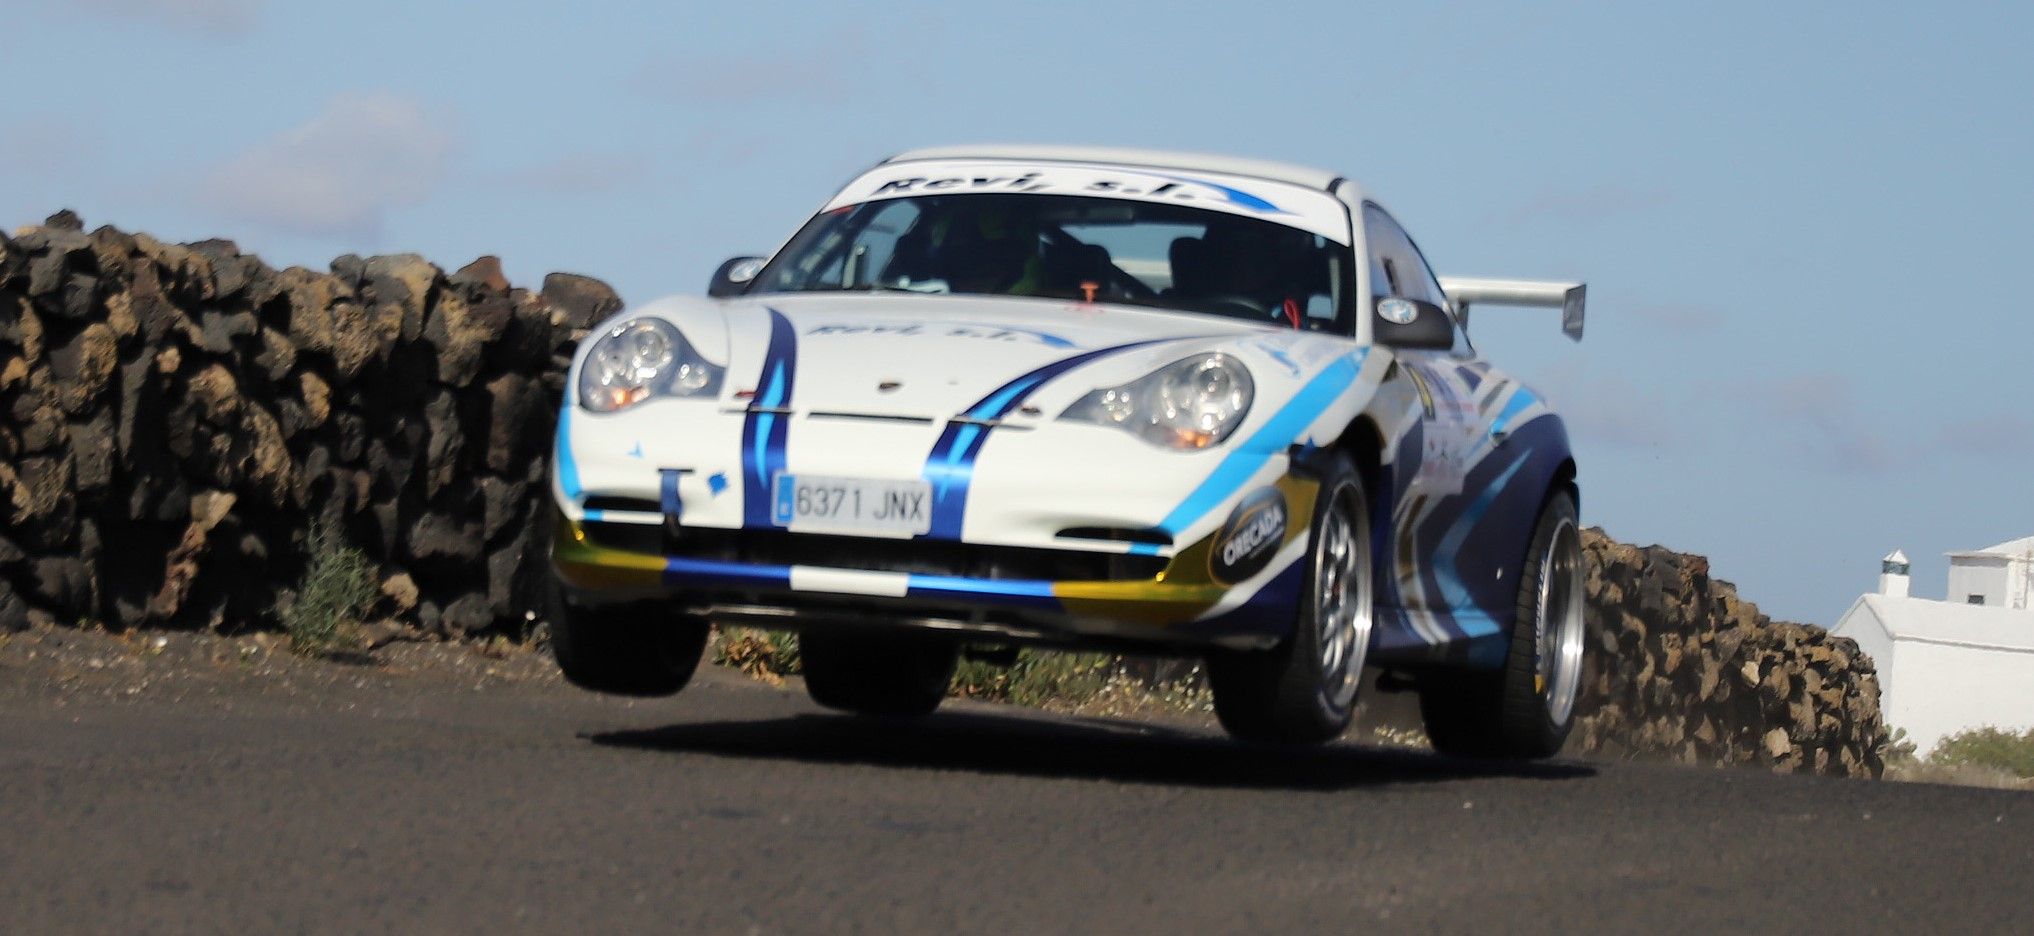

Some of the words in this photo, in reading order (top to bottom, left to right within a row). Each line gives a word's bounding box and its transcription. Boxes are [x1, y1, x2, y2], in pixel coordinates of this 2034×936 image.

[797, 485, 863, 519] 6371
[873, 490, 925, 522] JNX
[1223, 503, 1284, 567] ORECADA
